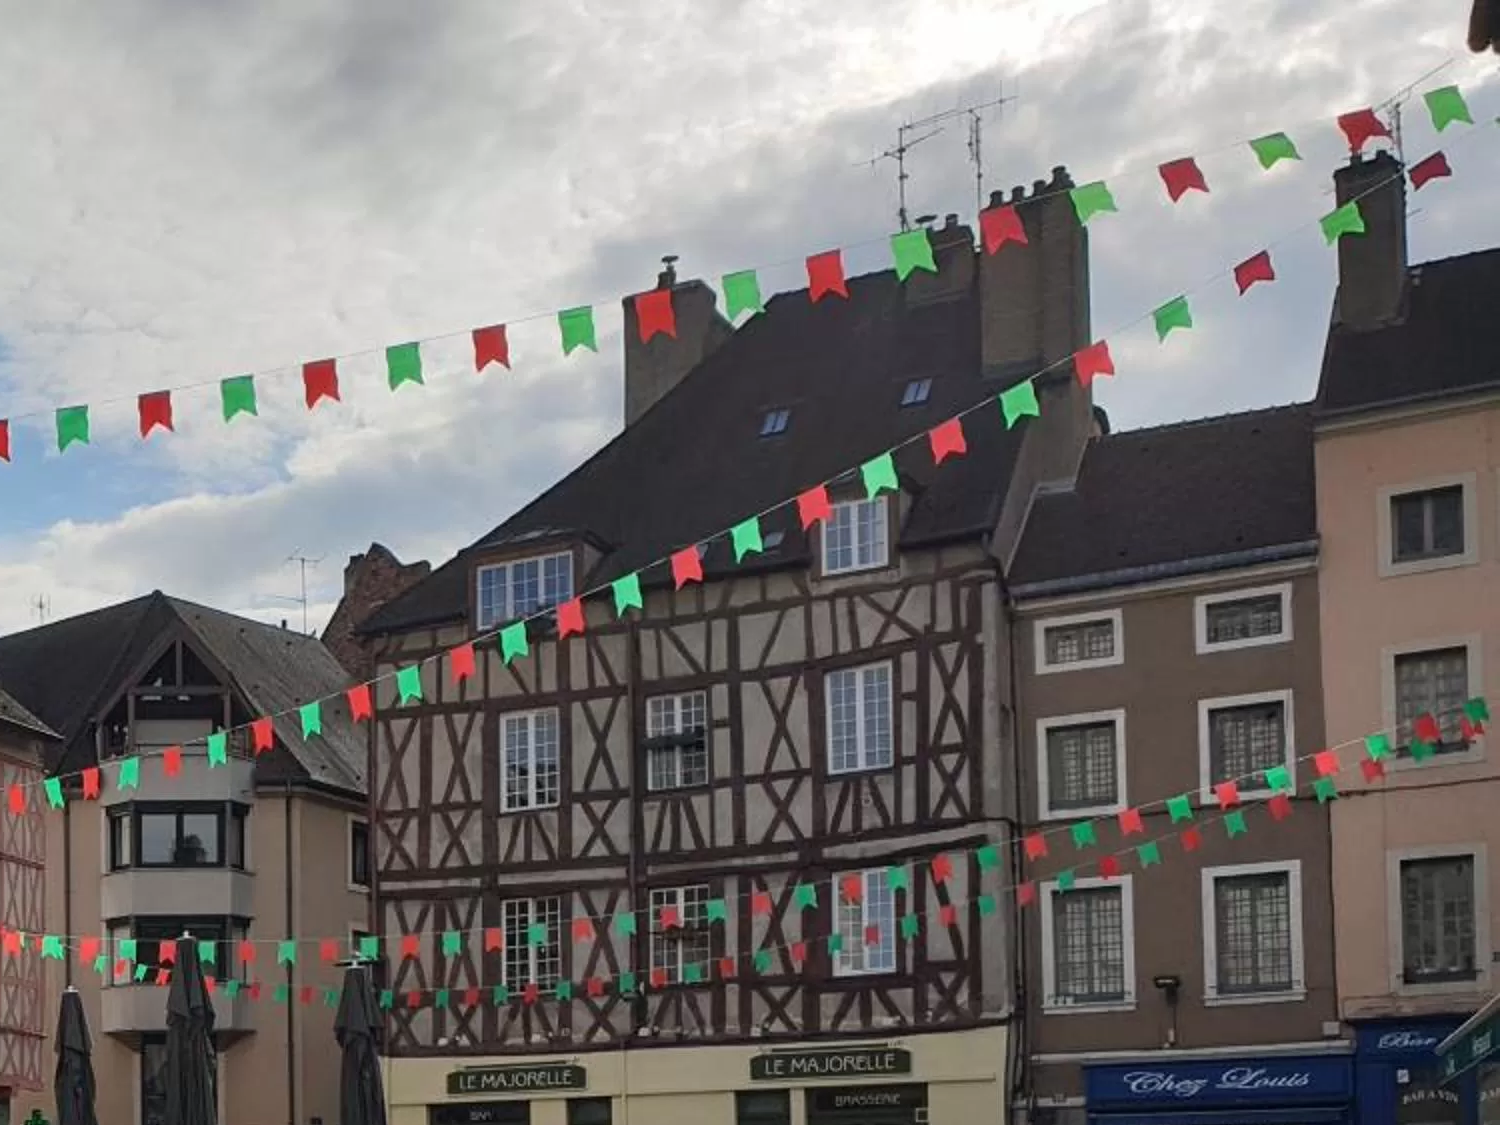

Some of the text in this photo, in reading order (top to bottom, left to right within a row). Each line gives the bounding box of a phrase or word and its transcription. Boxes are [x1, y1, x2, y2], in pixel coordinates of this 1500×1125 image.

[764, 1053, 896, 1076] LE MAJORELLE
[459, 1069, 573, 1090] LE MAJORELLE
[1123, 1067, 1311, 1097] Chez Louis
[835, 1093, 901, 1107] BRASSERIE
